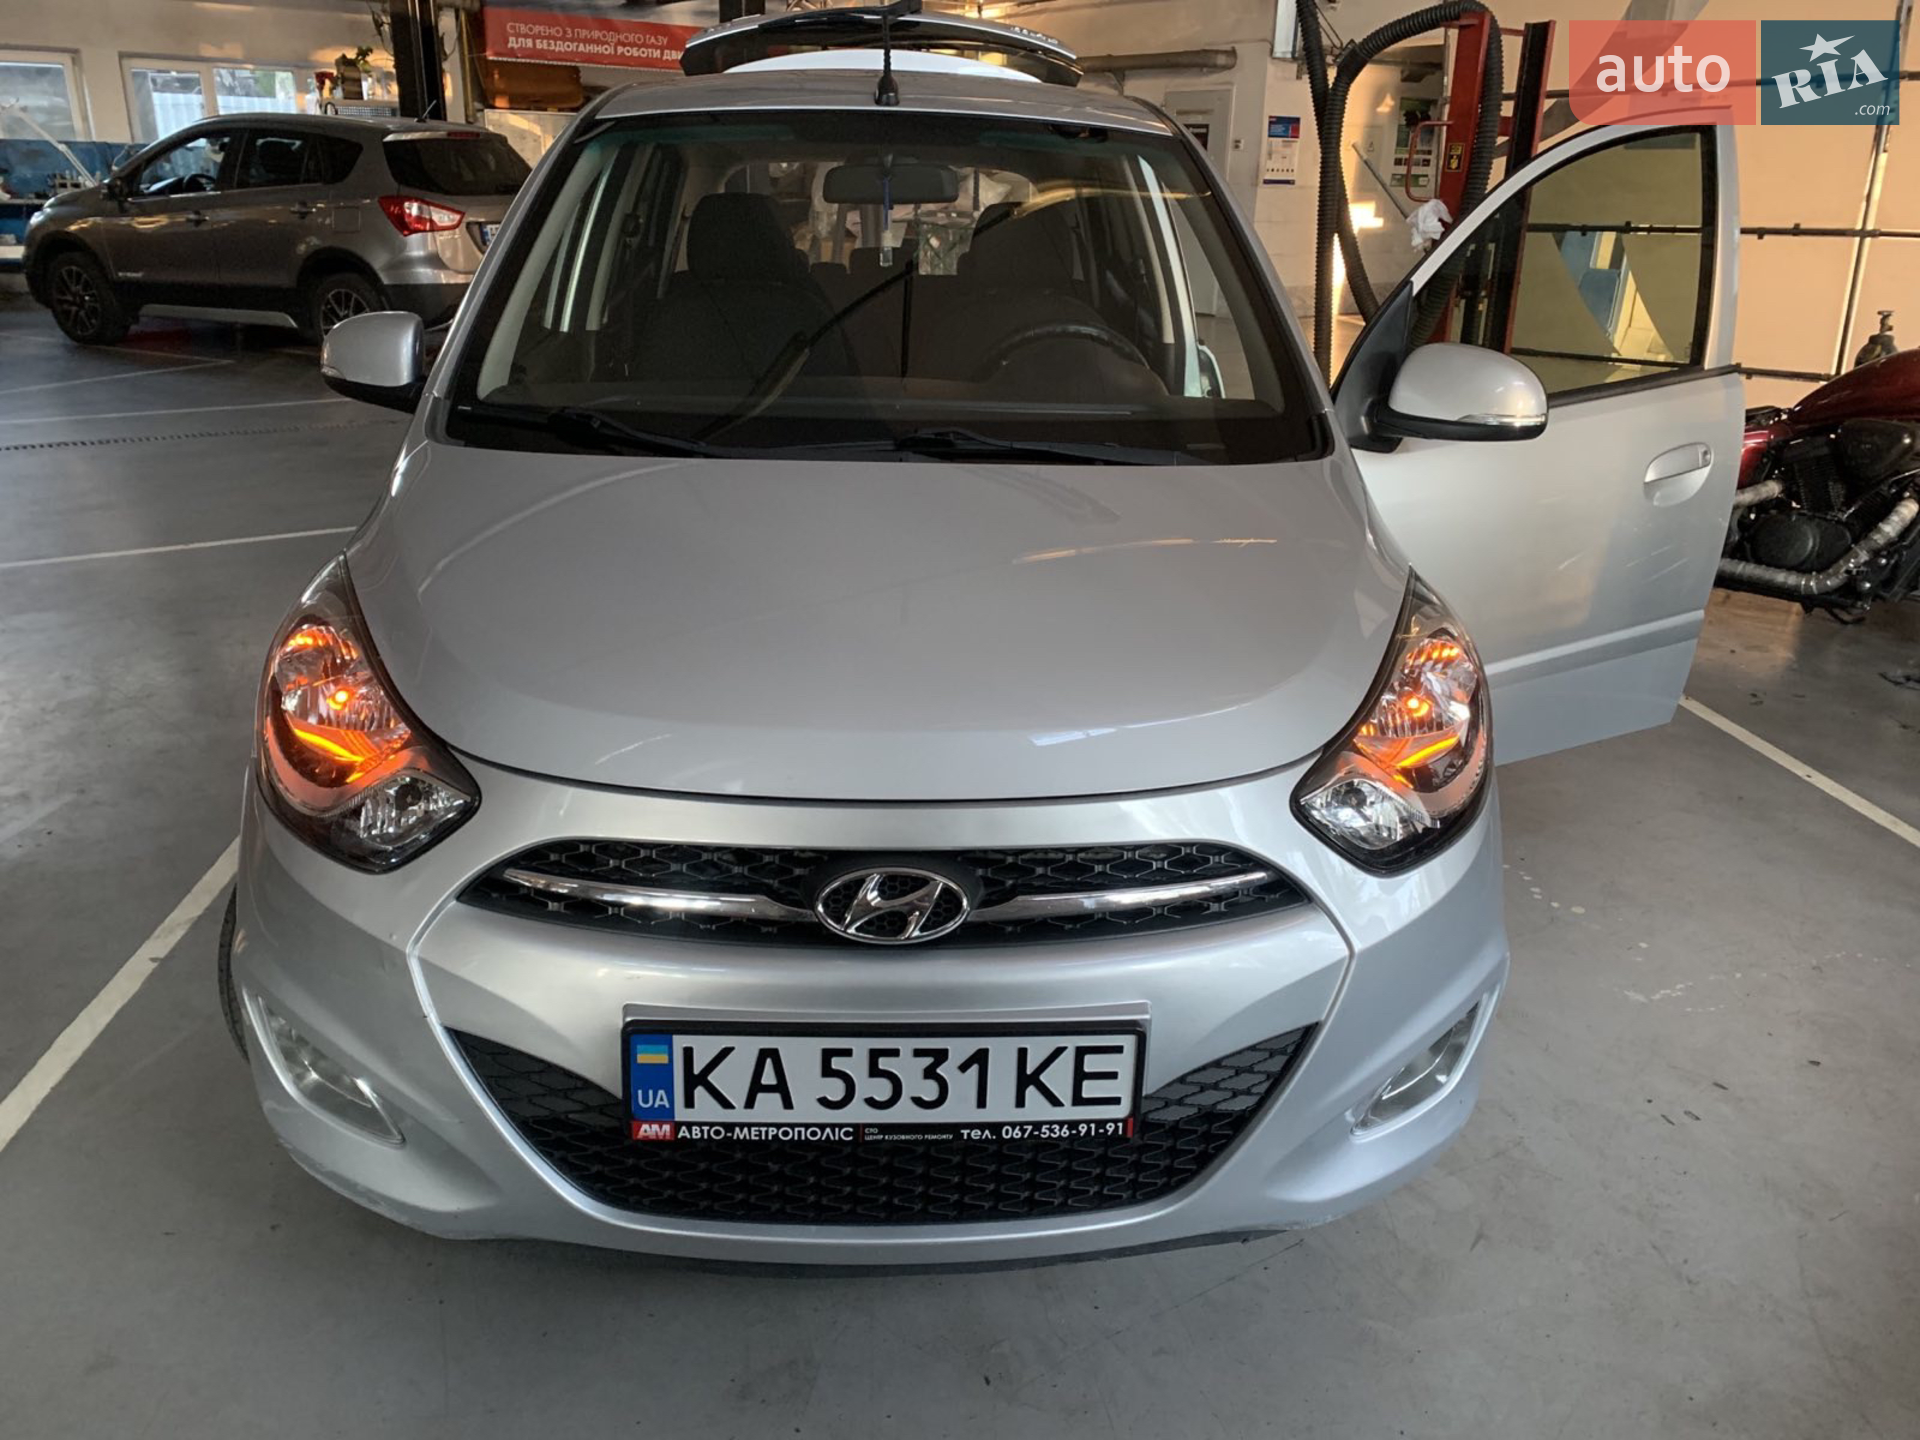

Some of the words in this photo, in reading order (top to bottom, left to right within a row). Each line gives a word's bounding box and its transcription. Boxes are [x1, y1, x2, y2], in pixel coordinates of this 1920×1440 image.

[507, 22, 562, 37] СТВОРЕНО
[575, 28, 644, 45] ПРИРОДНОГО
[646, 35, 668, 46] ГАЗУ
[508, 37, 533, 49] ДЛЯ
[536, 39, 614, 55] БЕЗДОГАННОЇ
[617, 47, 660, 59] РОБОТИ
[682, 1046, 794, 1110] KA
[816, 1047, 990, 1110] 5531
[1015, 1045, 1124, 1109] KE
[637, 1089, 670, 1109] UA
[677, 1125, 854, 1141] АВТО-МЕТРОПОЛІС
[960, 1128, 996, 1140] тел.
[1001, 1122, 1123, 1140] 067-536-91-91
